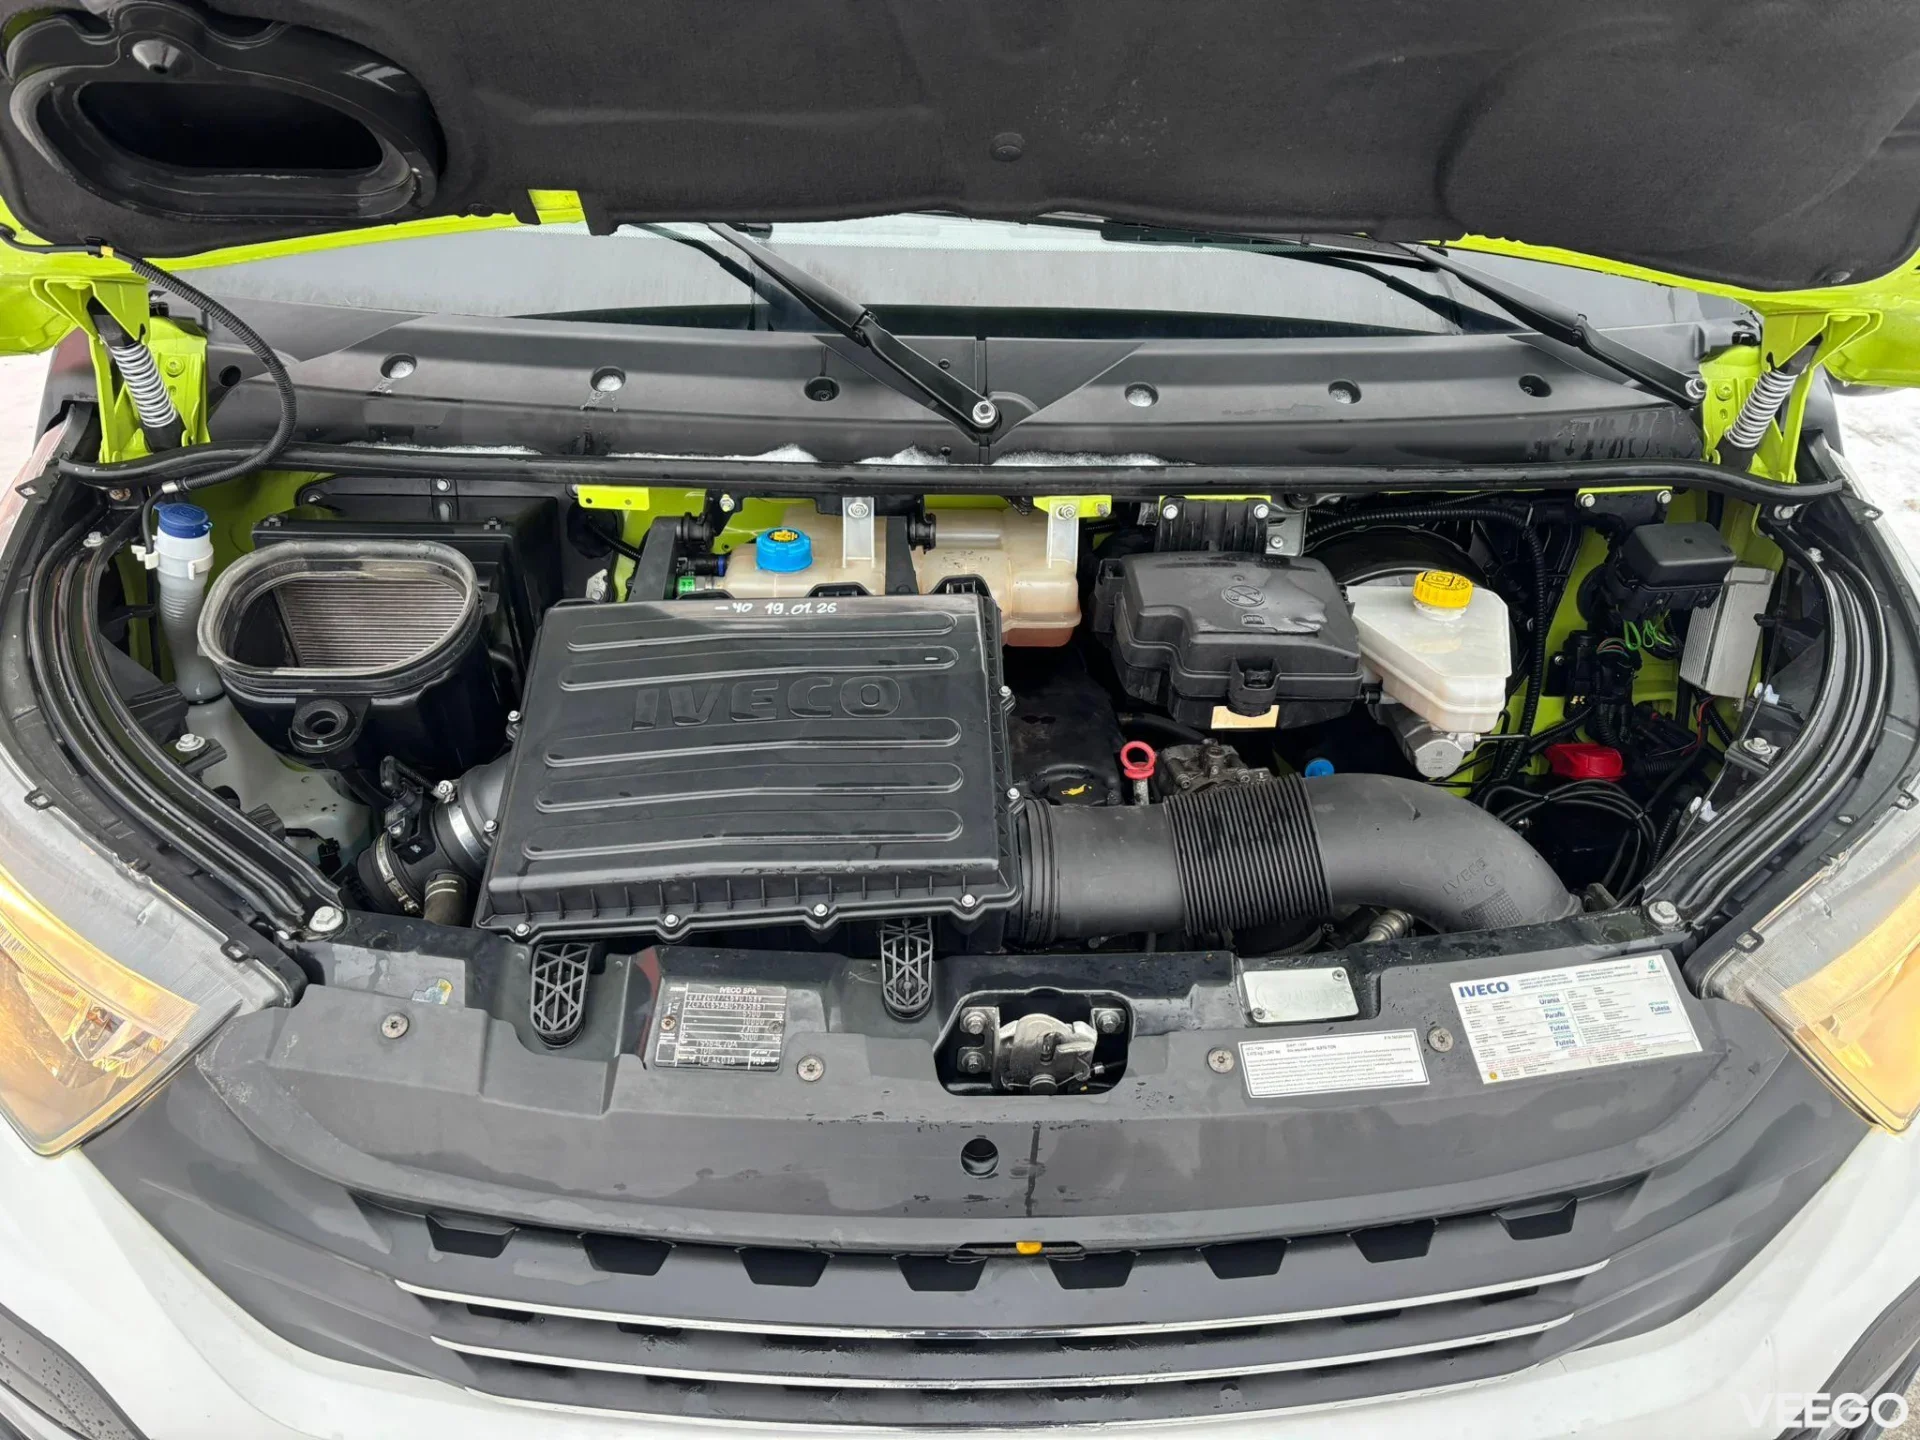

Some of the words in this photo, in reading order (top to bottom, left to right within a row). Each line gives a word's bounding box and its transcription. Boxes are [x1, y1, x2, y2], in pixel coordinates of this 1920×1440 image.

[631, 675, 901, 731] IVECO
[1458, 981, 1510, 998] IVECO
[1549, 1024, 1571, 1032] Tutela
[1555, 1039, 1576, 1047] Tutela
